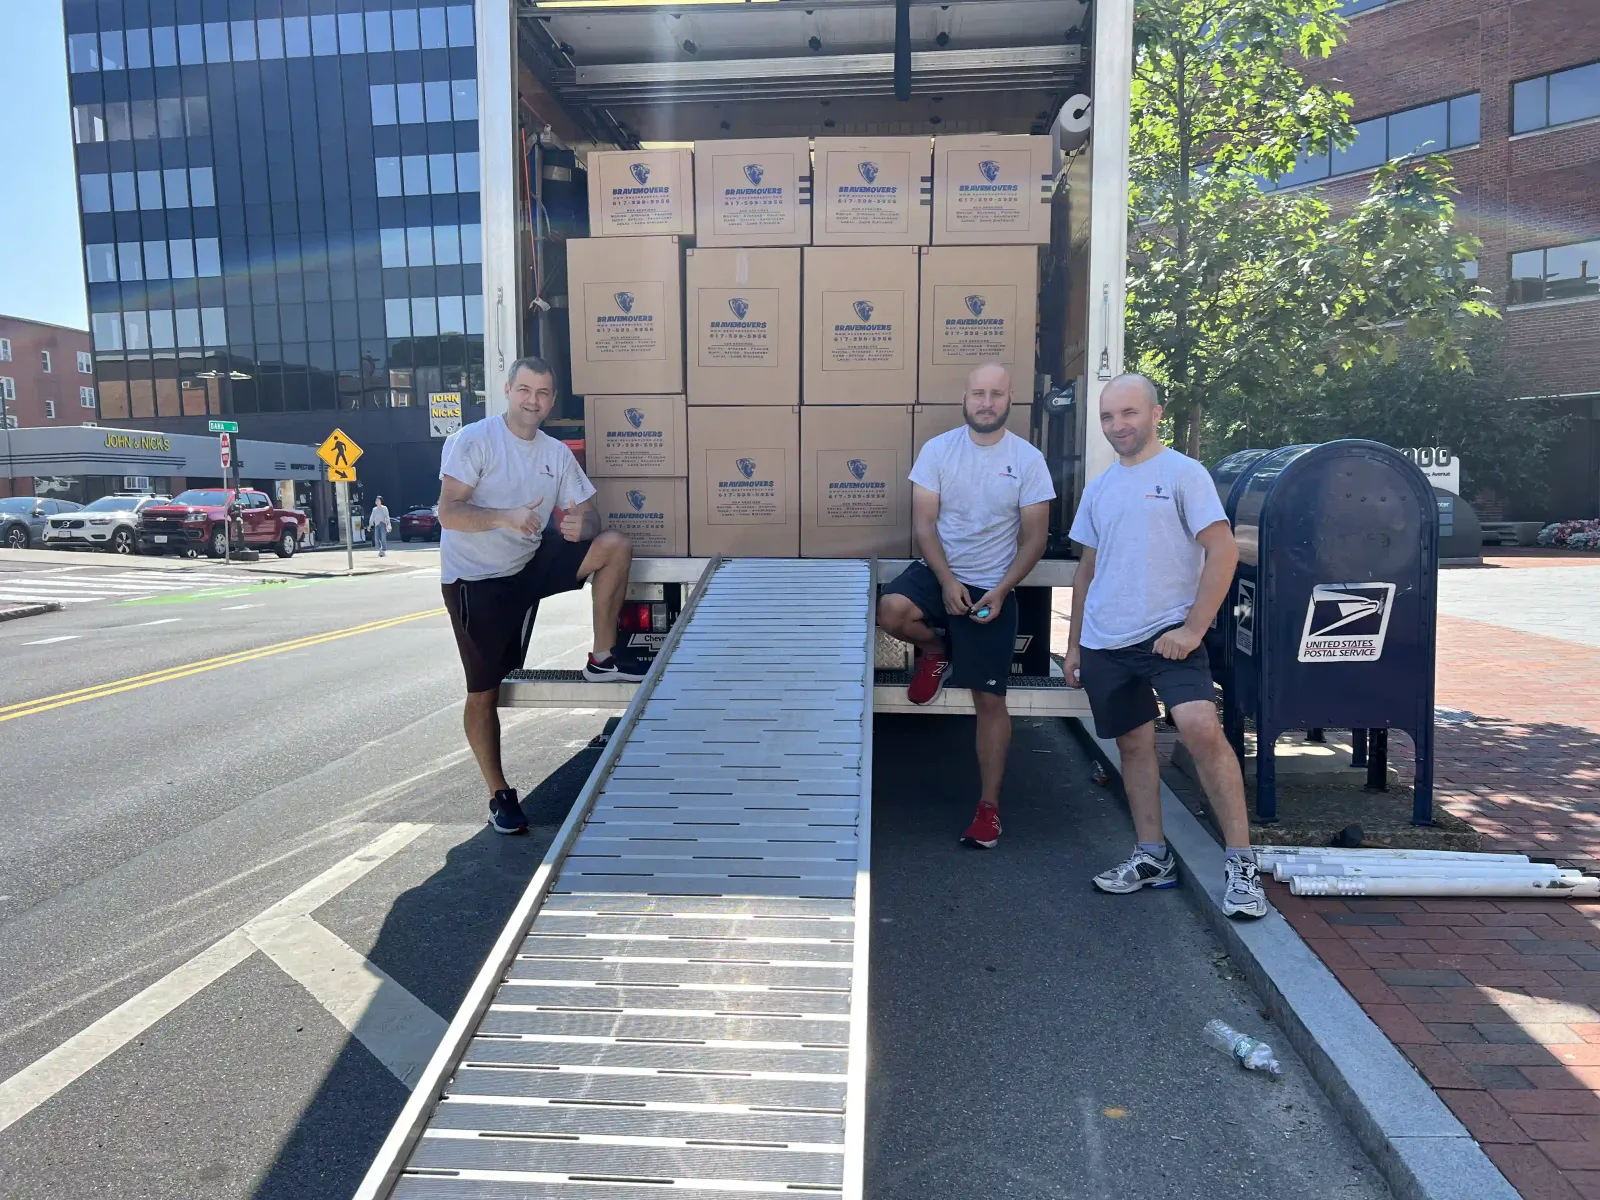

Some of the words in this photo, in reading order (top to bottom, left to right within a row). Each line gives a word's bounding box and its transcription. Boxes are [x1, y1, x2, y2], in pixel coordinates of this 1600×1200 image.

[431, 394, 459, 405] JOHN
[104, 433, 131, 448] JOHN
[132, 438, 139, 449] &
[140, 436, 170, 452] NICK'S
